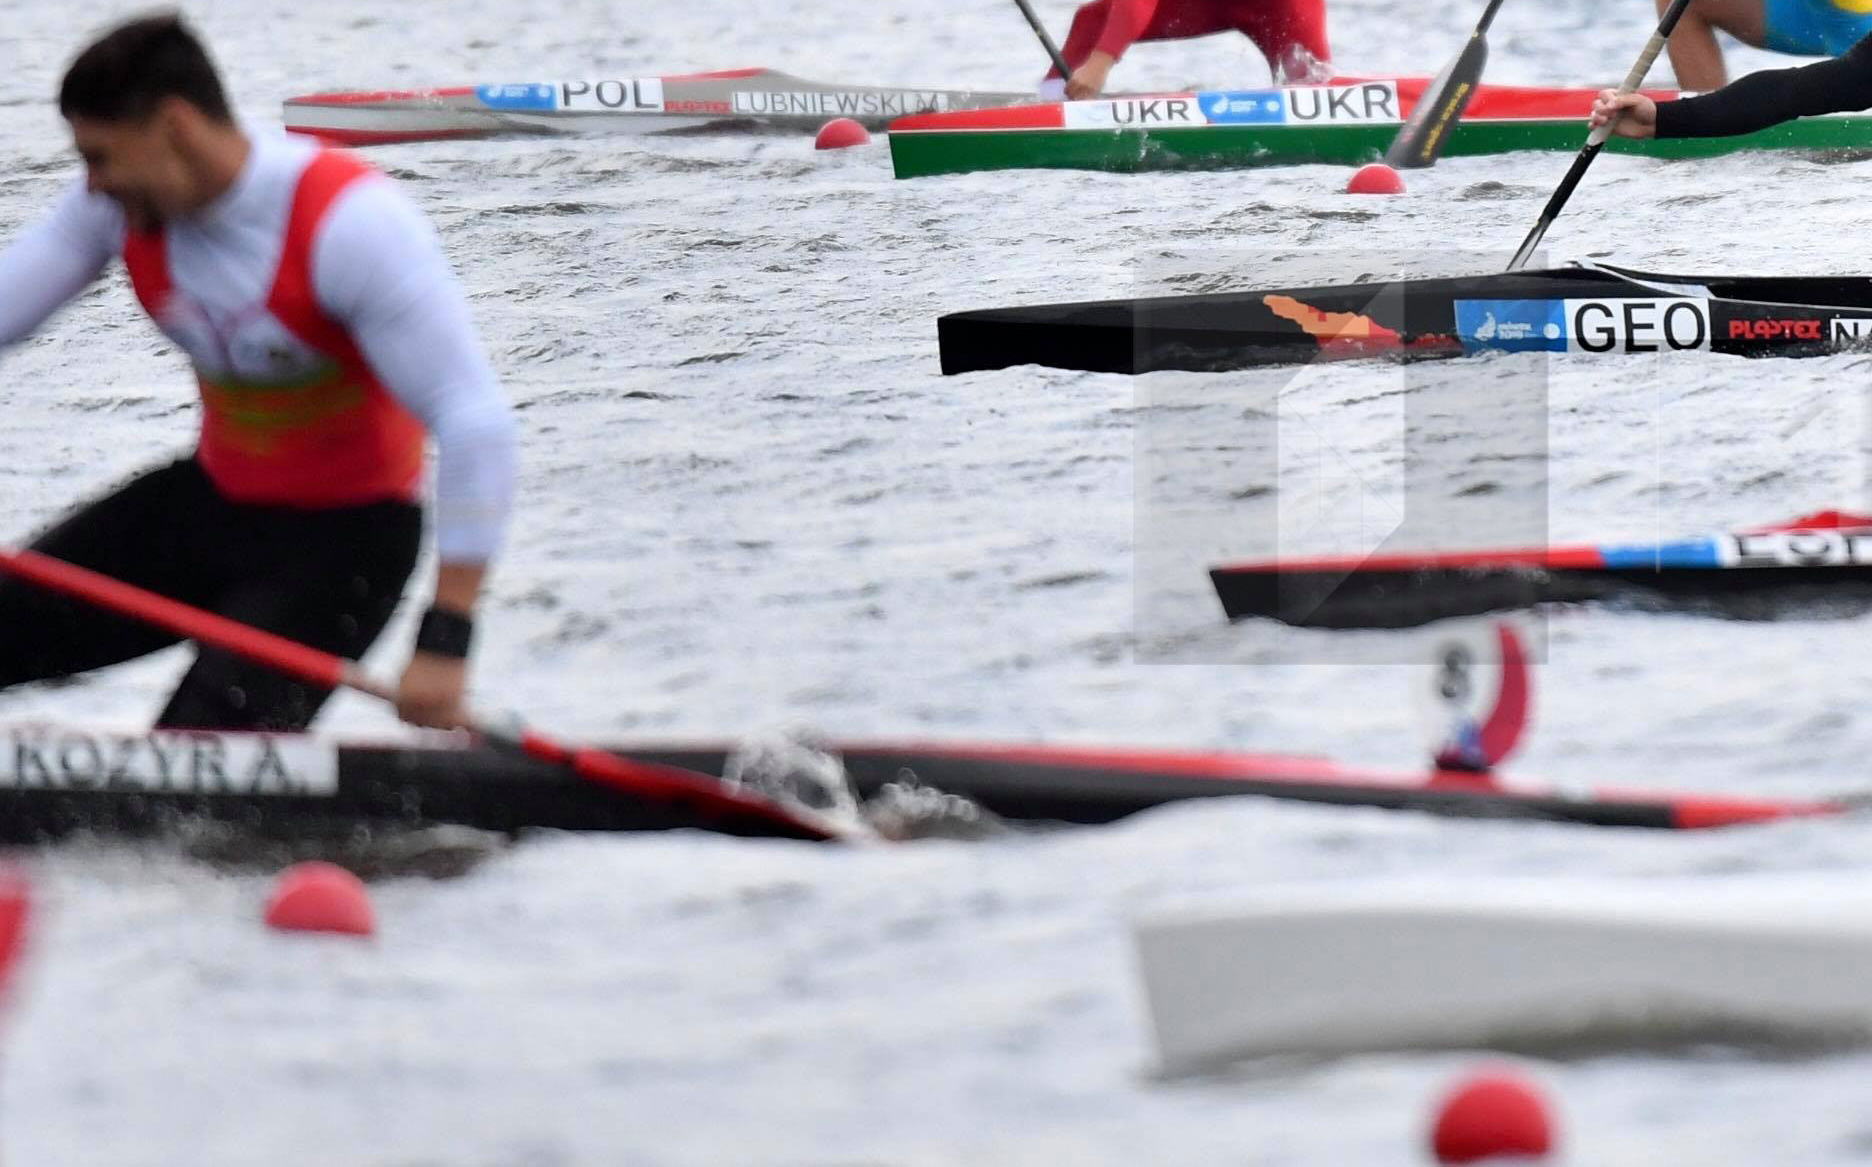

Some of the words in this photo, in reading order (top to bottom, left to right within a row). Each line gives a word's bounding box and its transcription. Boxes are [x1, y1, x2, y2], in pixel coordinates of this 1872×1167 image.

[563, 79, 659, 108] POL
[1290, 84, 1396, 120] UKR
[1112, 100, 1190, 123] UKR
[1574, 301, 1706, 352] GEO
